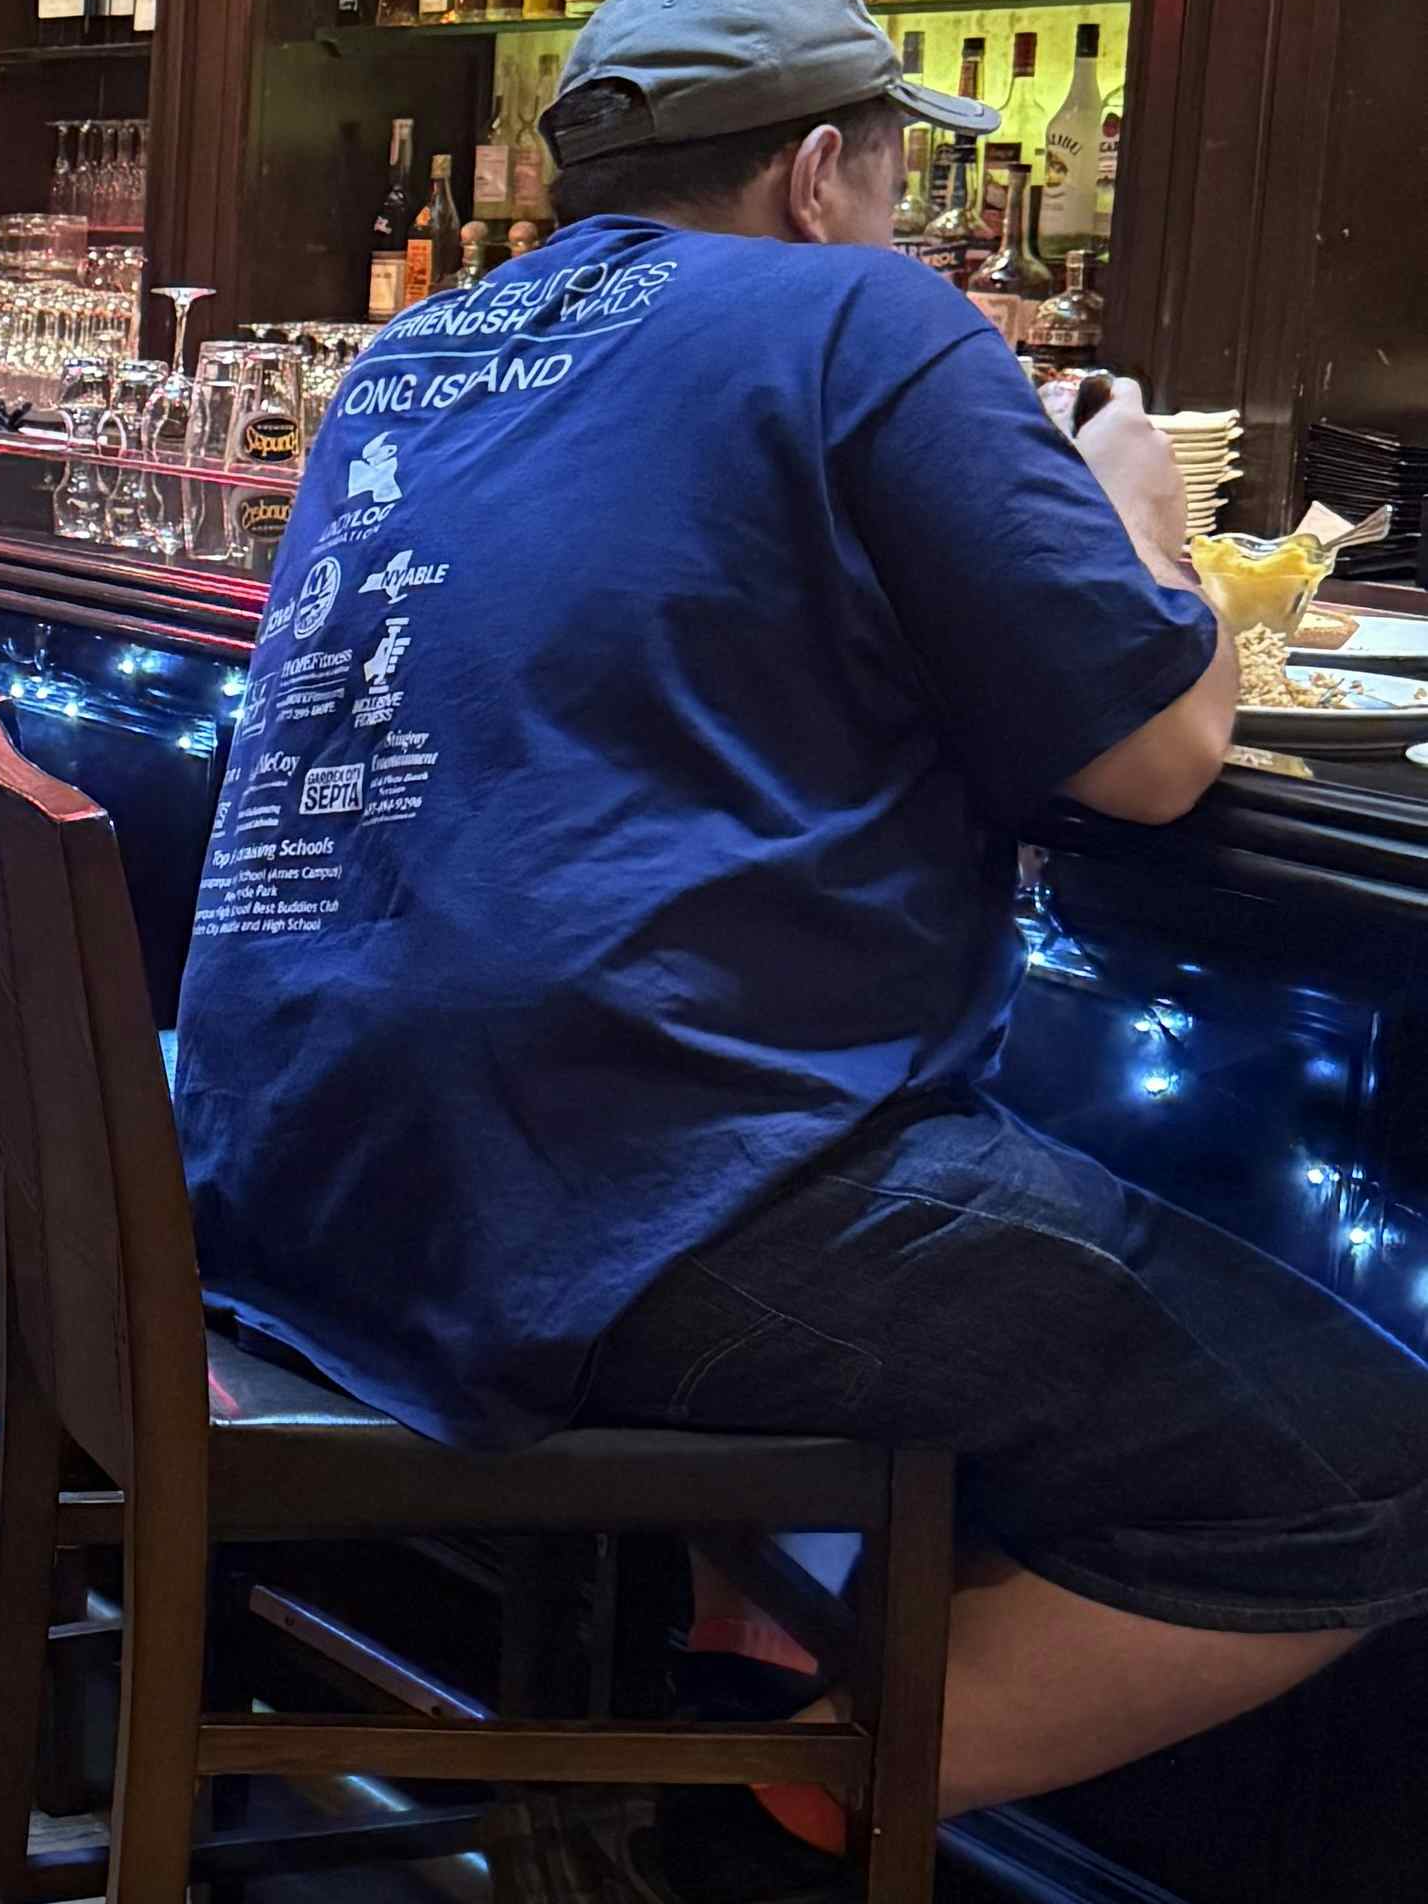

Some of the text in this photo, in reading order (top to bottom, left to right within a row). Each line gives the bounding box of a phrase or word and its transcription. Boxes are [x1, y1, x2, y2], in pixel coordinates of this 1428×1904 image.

[384, 285, 664, 341] FRIENDSHI WALK
[336, 373, 418, 418] ONG
[304, 783, 360, 812] SEPTA
[279, 836, 336, 857] Schools
[255, 884, 278, 897] Park
[252, 901, 276, 915] Best
[277, 900, 318, 915] Buddies
[319, 899, 340, 913] Club
[240, 920, 261, 933] and
[261, 918, 286, 934] High
[287, 917, 322, 932] School
